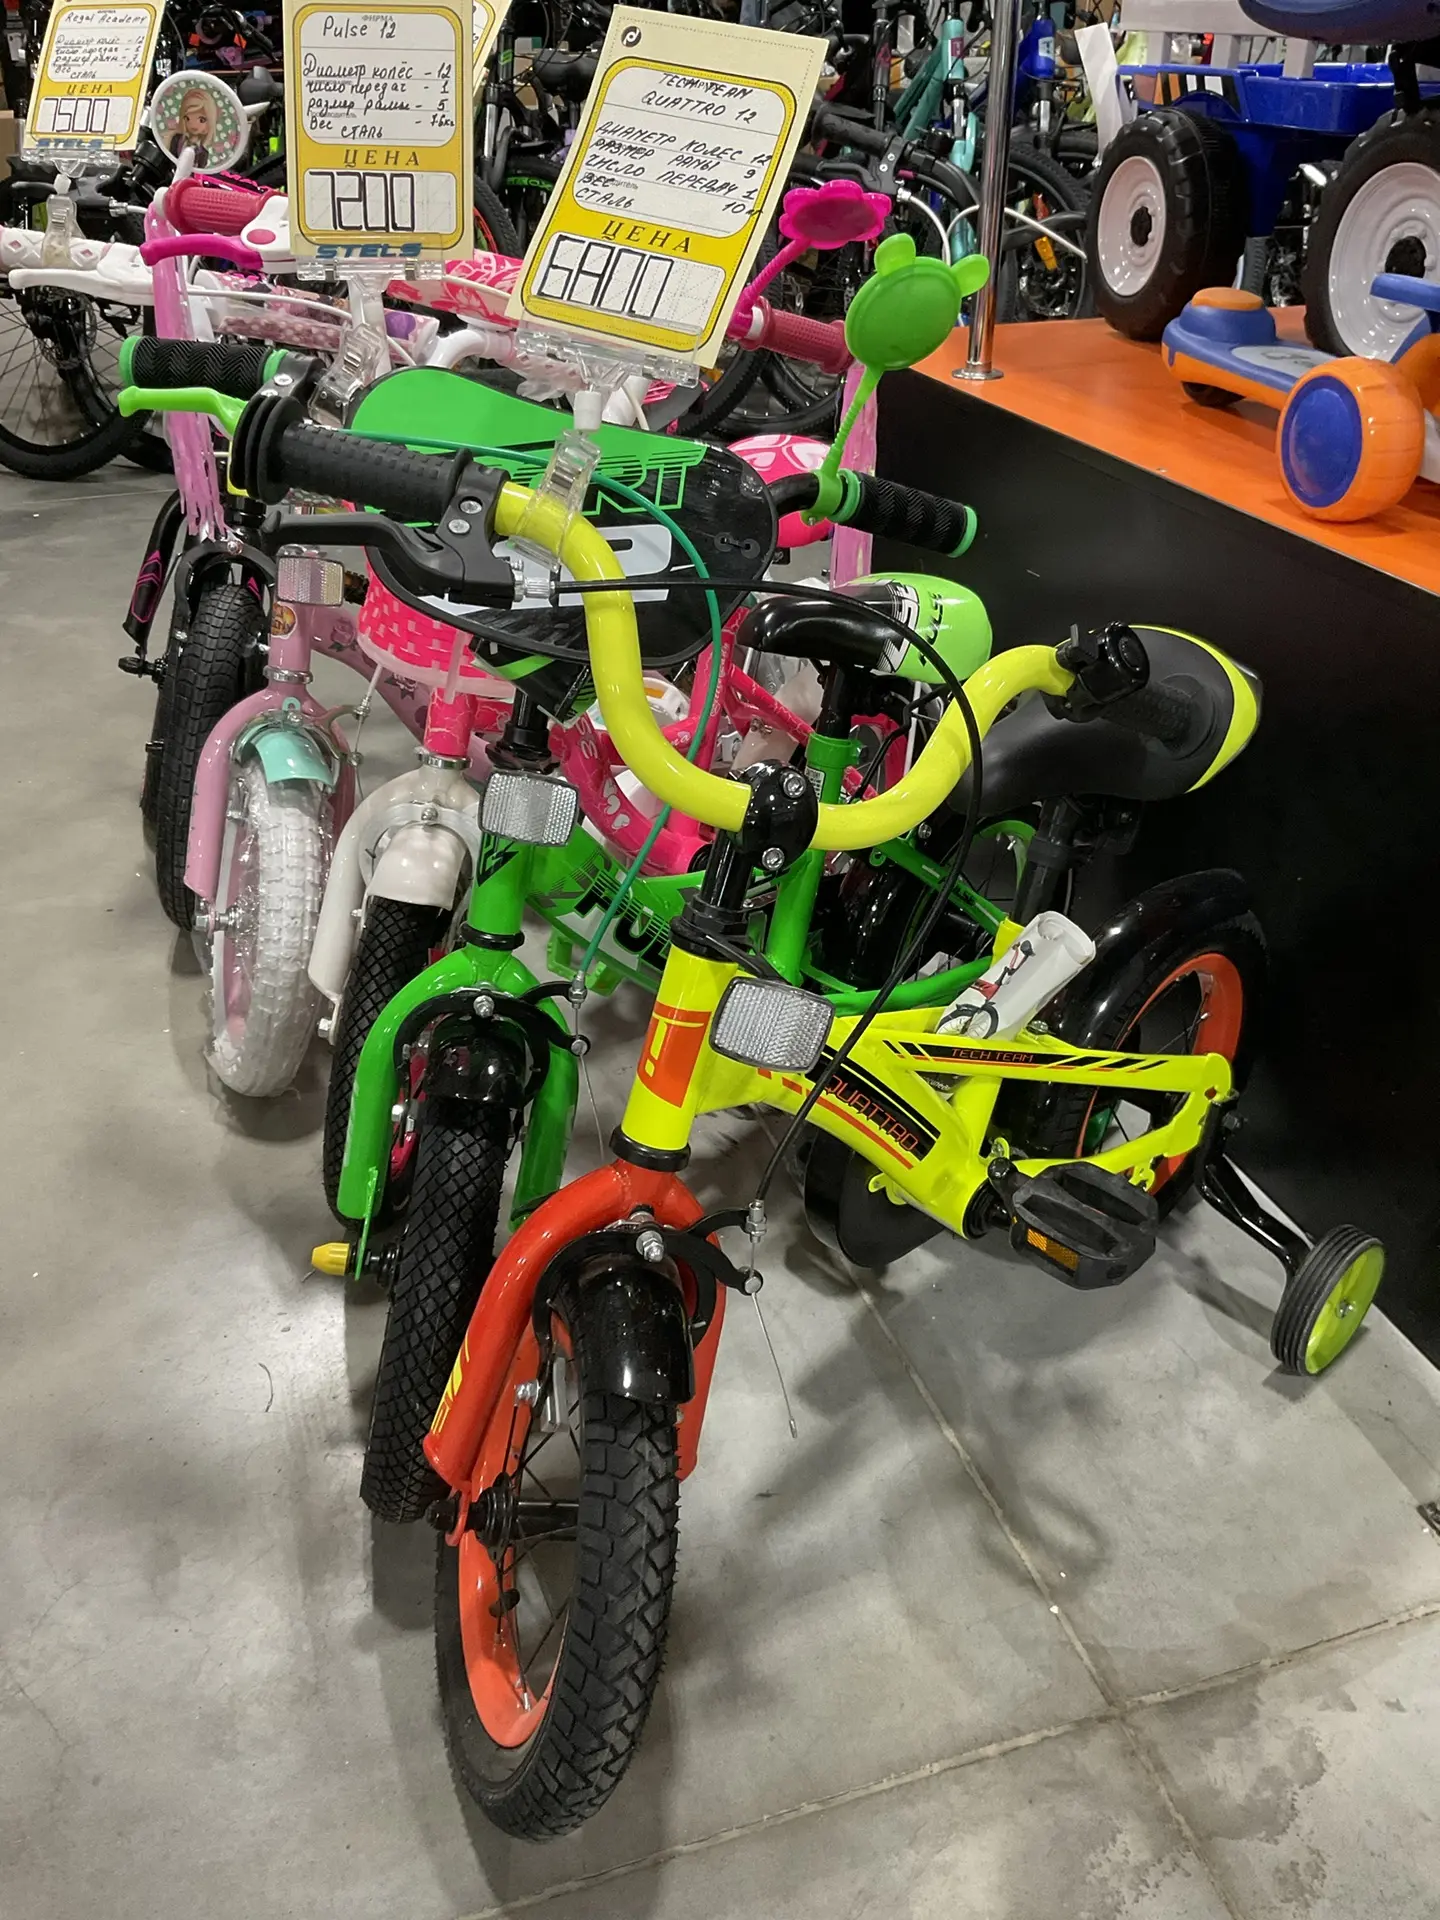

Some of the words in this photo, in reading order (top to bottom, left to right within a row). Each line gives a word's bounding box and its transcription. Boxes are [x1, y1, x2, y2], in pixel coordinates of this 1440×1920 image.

[65, 12, 95, 23] Regal
[323, 15, 368, 39] Pulse
[379, 21, 397, 39] 12
[437, 62, 452, 79] 12
[66, 84, 113, 95] ЦЕНА
[440, 80, 450, 94] 1
[437, 98, 449, 111] 5
[641, 90, 727, 117] QUATTRO
[735, 108, 757, 124] 12
[45, 98, 110, 134] 7500
[595, 121, 677, 146] ДИАМЕТР
[680, 139, 743, 161] КОЛЕС
[750, 153, 773, 166] 12
[343, 149, 420, 168] ЦЕНА
[589, 138, 655, 160] РАЗМЕР
[667, 154, 720, 171] РАМЫ
[743, 169, 757, 179] 9
[578, 172, 616, 187] ВЕС
[585, 153, 645, 177] ЧИСЛО
[656, 170, 739, 196] ПЕРЕДАЧ
[741, 188, 759, 200] 1
[309, 171, 415, 232] 7200
[575, 187, 635, 208] СТАЛЬ
[601, 220, 691, 253] ЦЕНА
[315, 243, 422, 259] STELS
[952, 1048, 991, 1060] TECH
[995, 1052, 1034, 1063] TEAM
